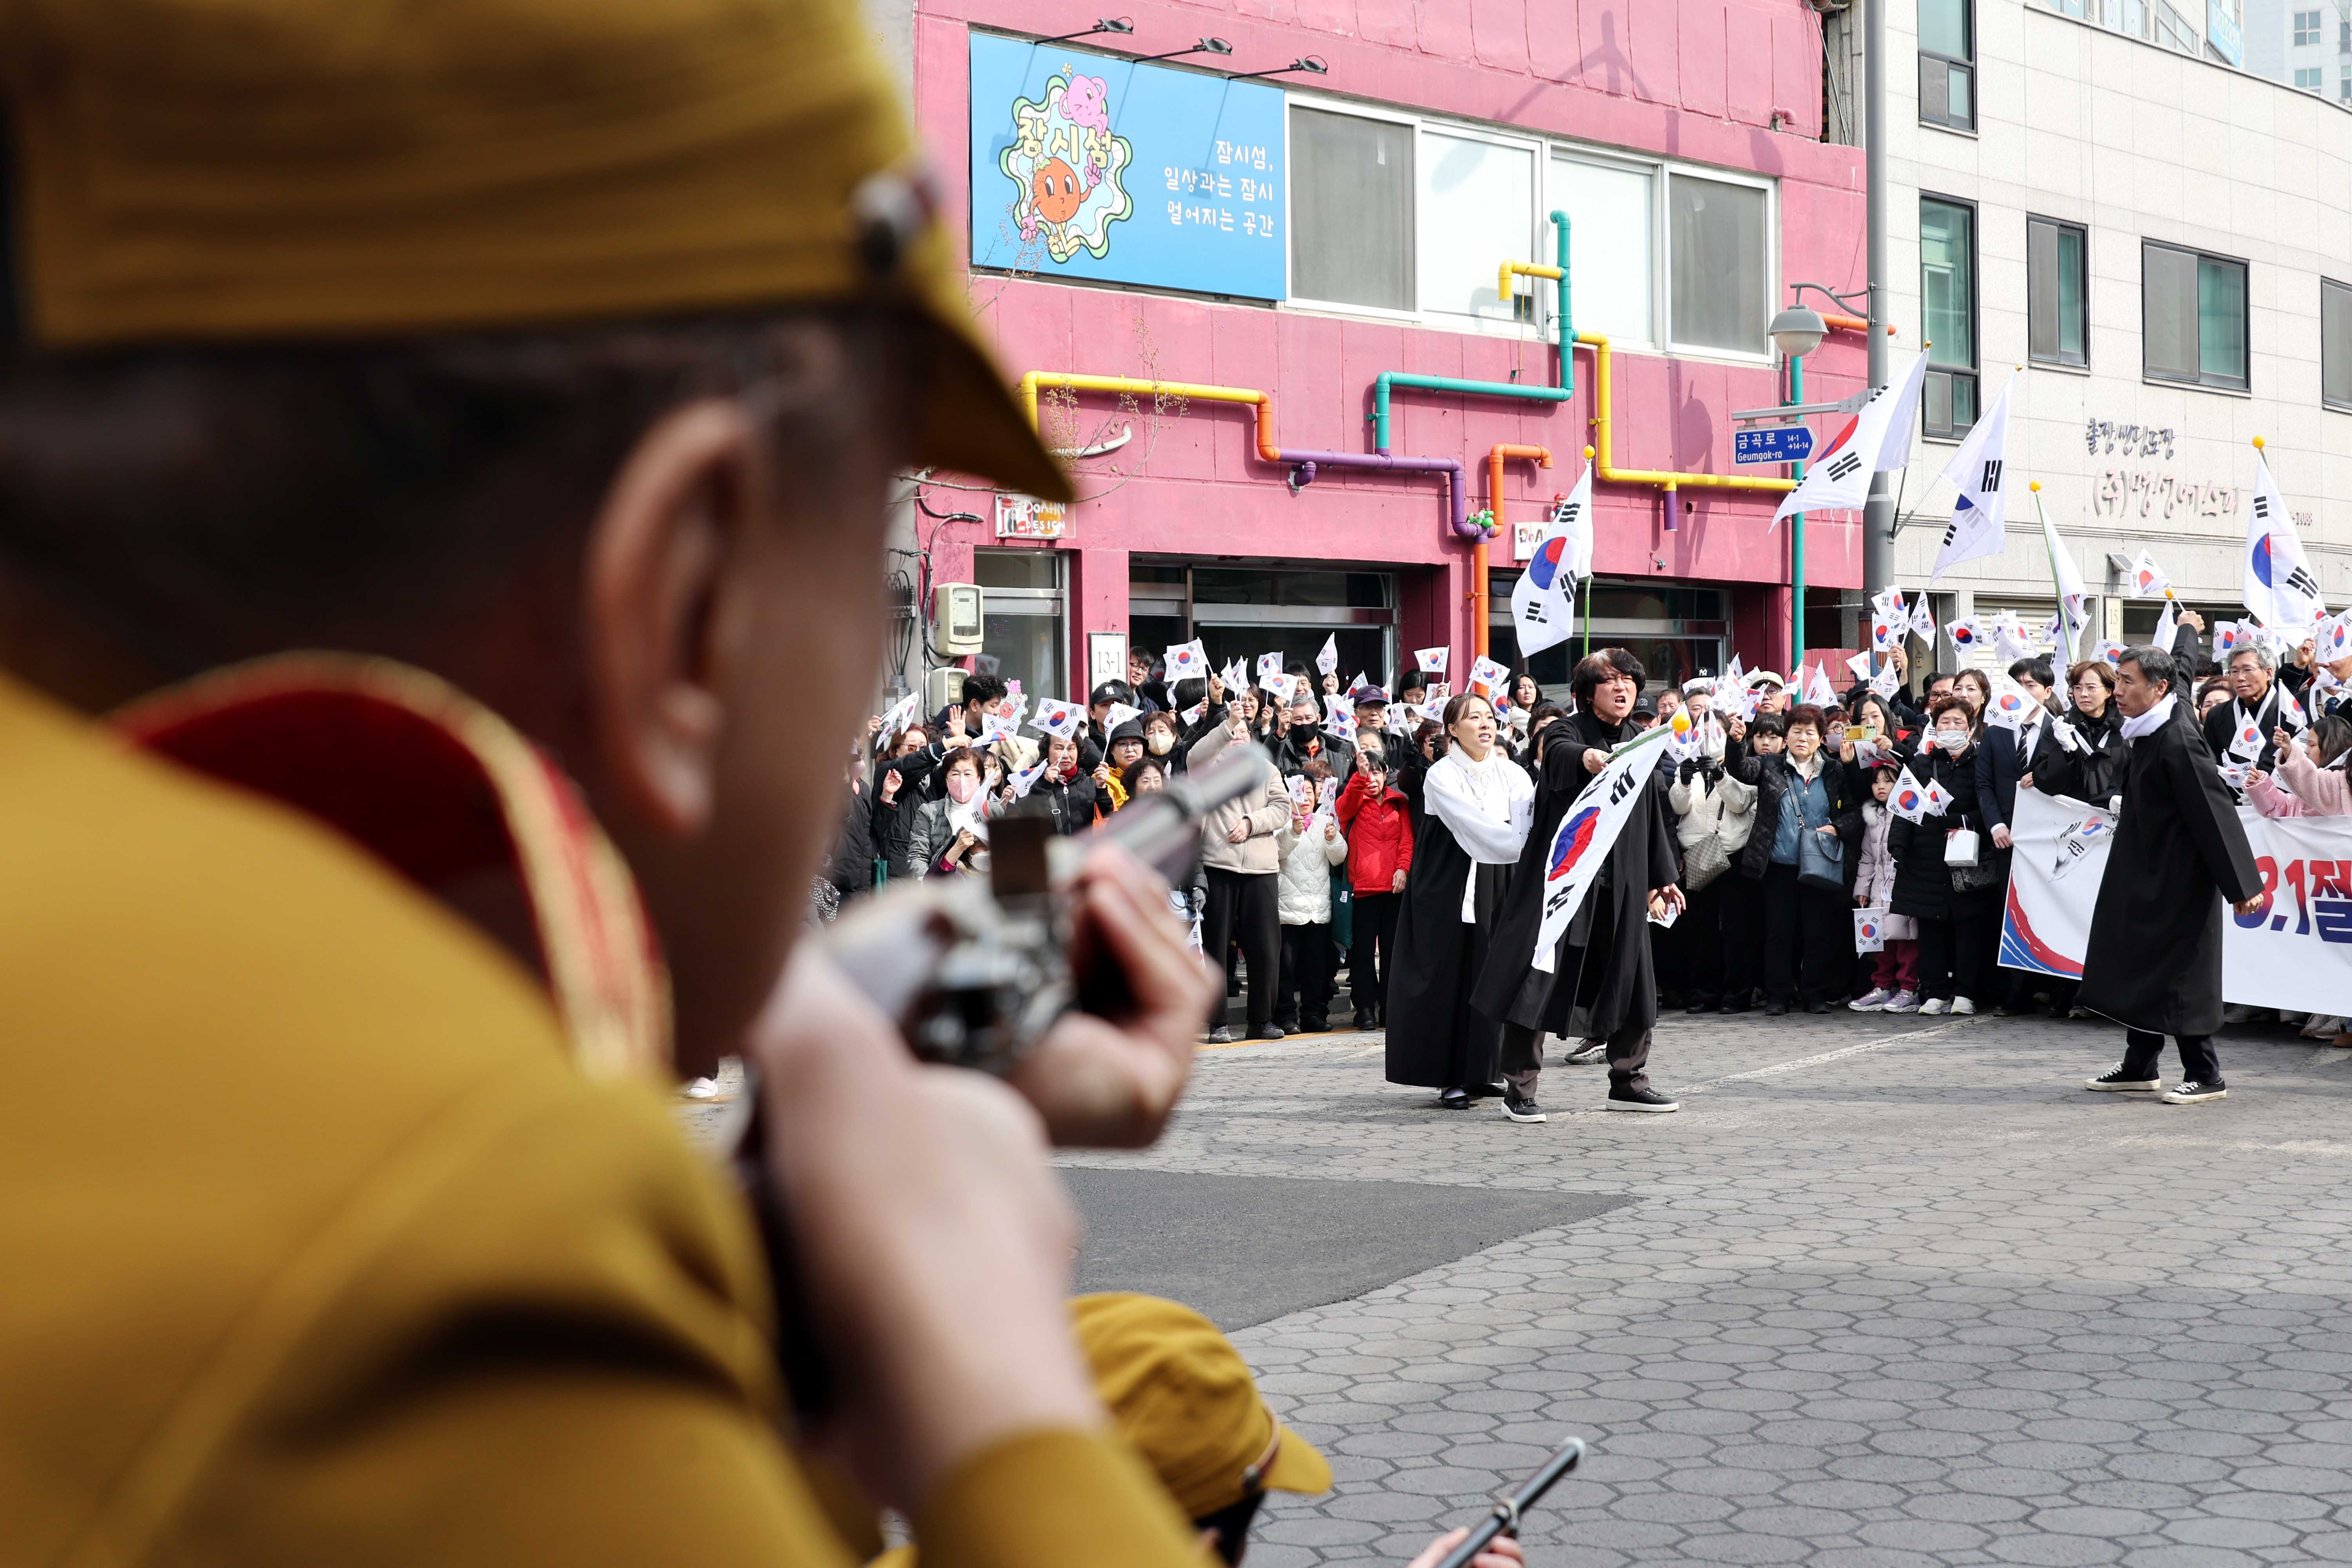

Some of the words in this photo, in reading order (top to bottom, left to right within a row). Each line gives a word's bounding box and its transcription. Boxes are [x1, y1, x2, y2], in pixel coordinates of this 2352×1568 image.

[1018, 117, 1112, 169] 잠시섬
[1216, 140, 1273, 172] 잠시섬,
[1164, 166, 1232, 197] 일상과는
[1240, 178, 1273, 201] 잠시
[1167, 200, 1234, 231] 멀어지는
[1243, 211, 1274, 237] 공간
[1737, 432, 1777, 449] 금곡로
[1737, 450, 1782, 462] Geumgok-ro
[1025, 520, 1065, 530] DESIGN
[2109, 609, 2118, 624] 15
[1098, 651, 1122, 673] 13-1
